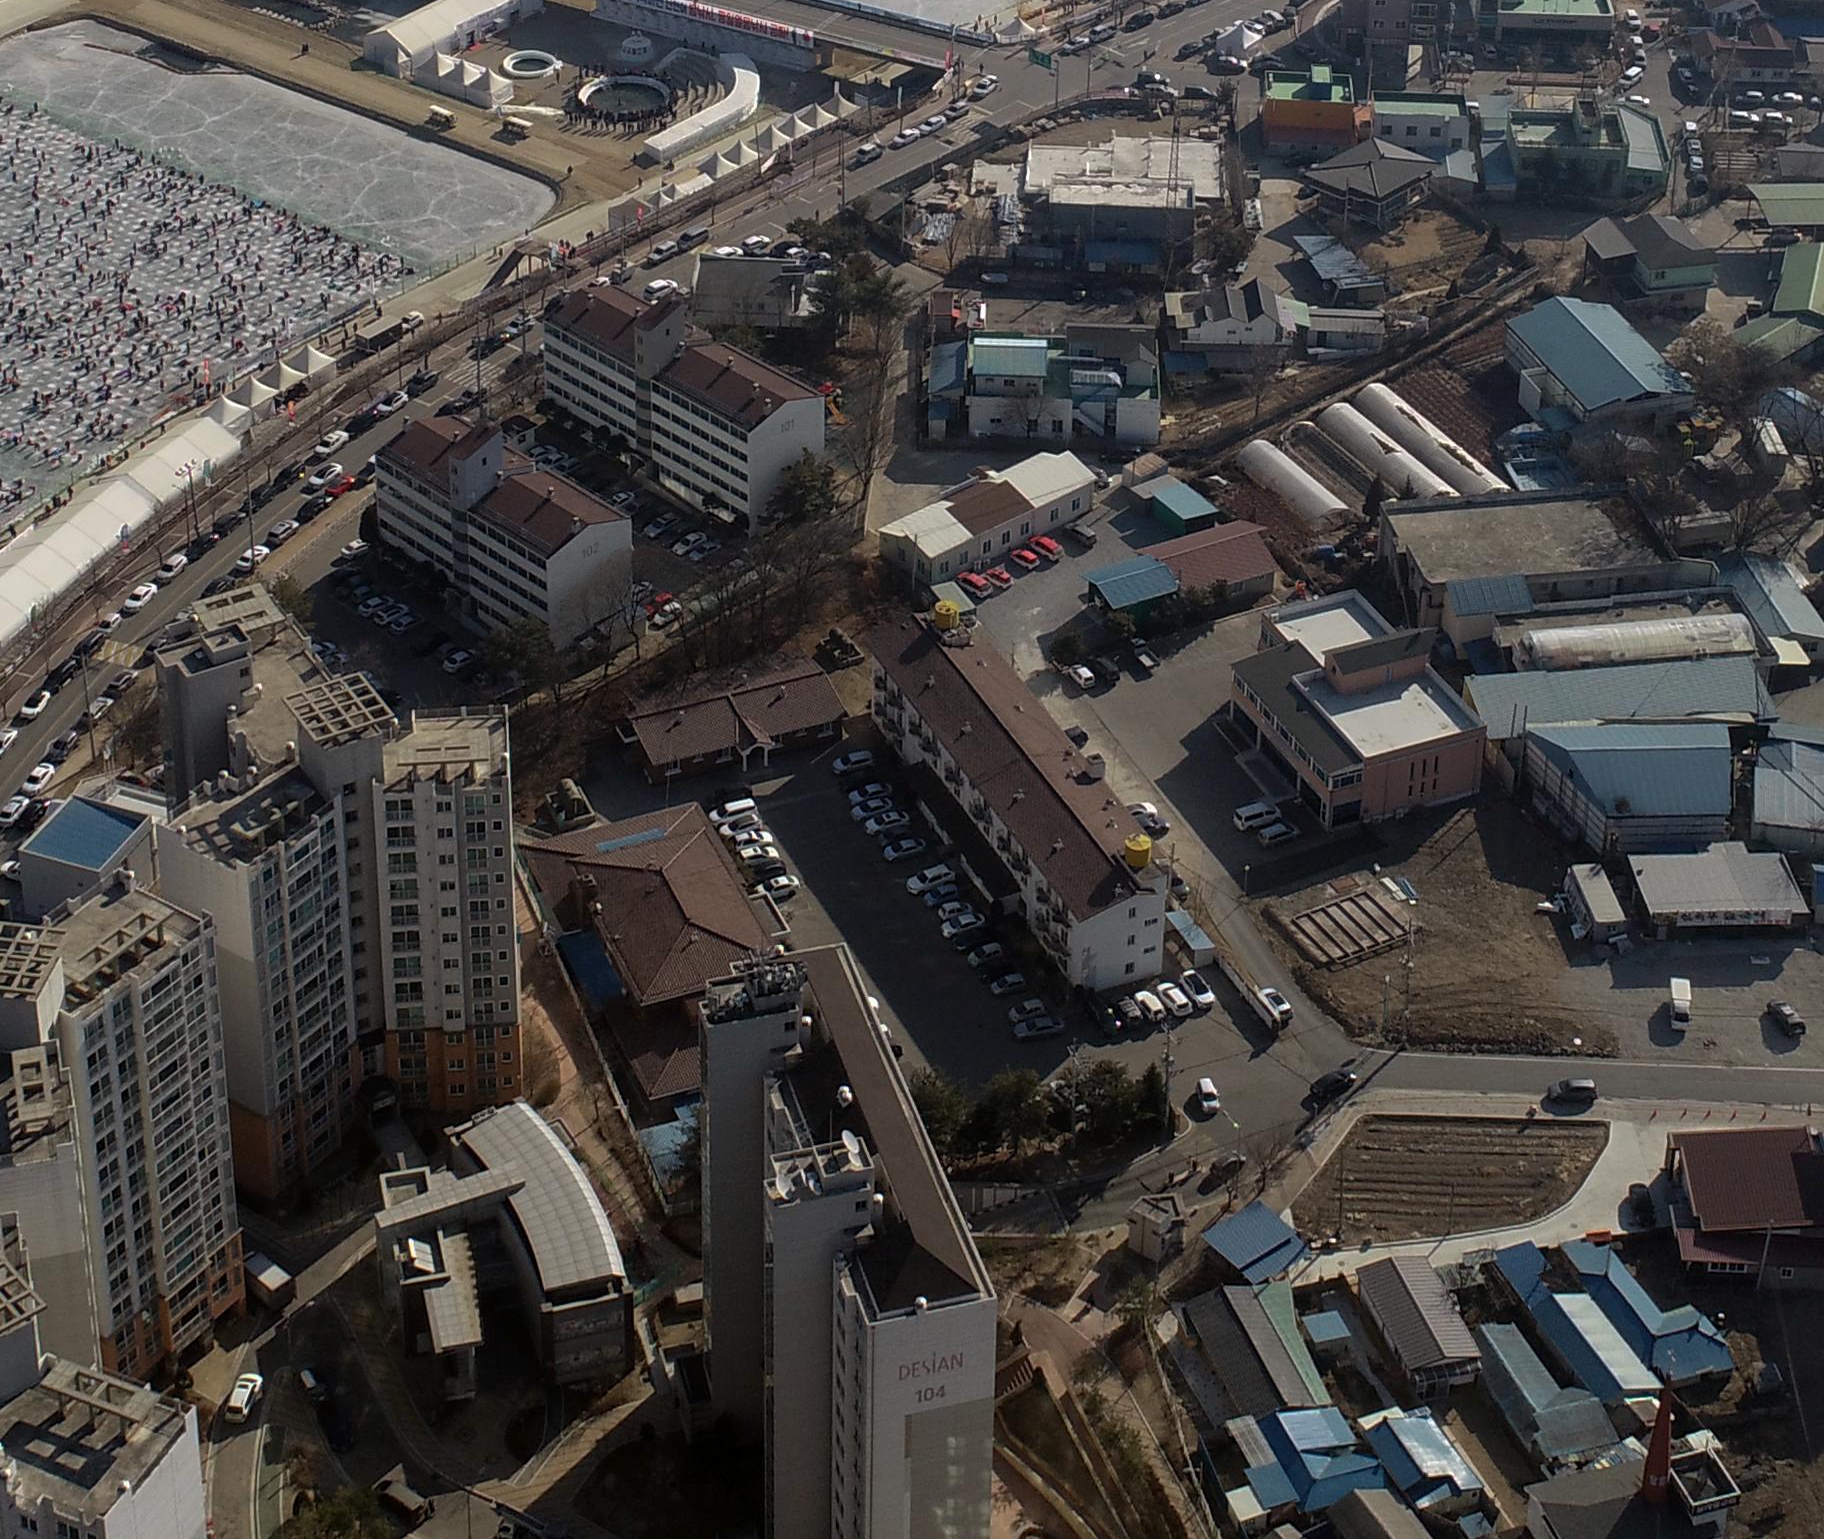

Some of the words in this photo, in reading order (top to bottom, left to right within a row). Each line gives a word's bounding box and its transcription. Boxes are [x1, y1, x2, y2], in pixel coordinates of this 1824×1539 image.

[781, 419, 795, 433] 101
[582, 542, 599, 558] 102
[915, 1385, 946, 1404] 104
